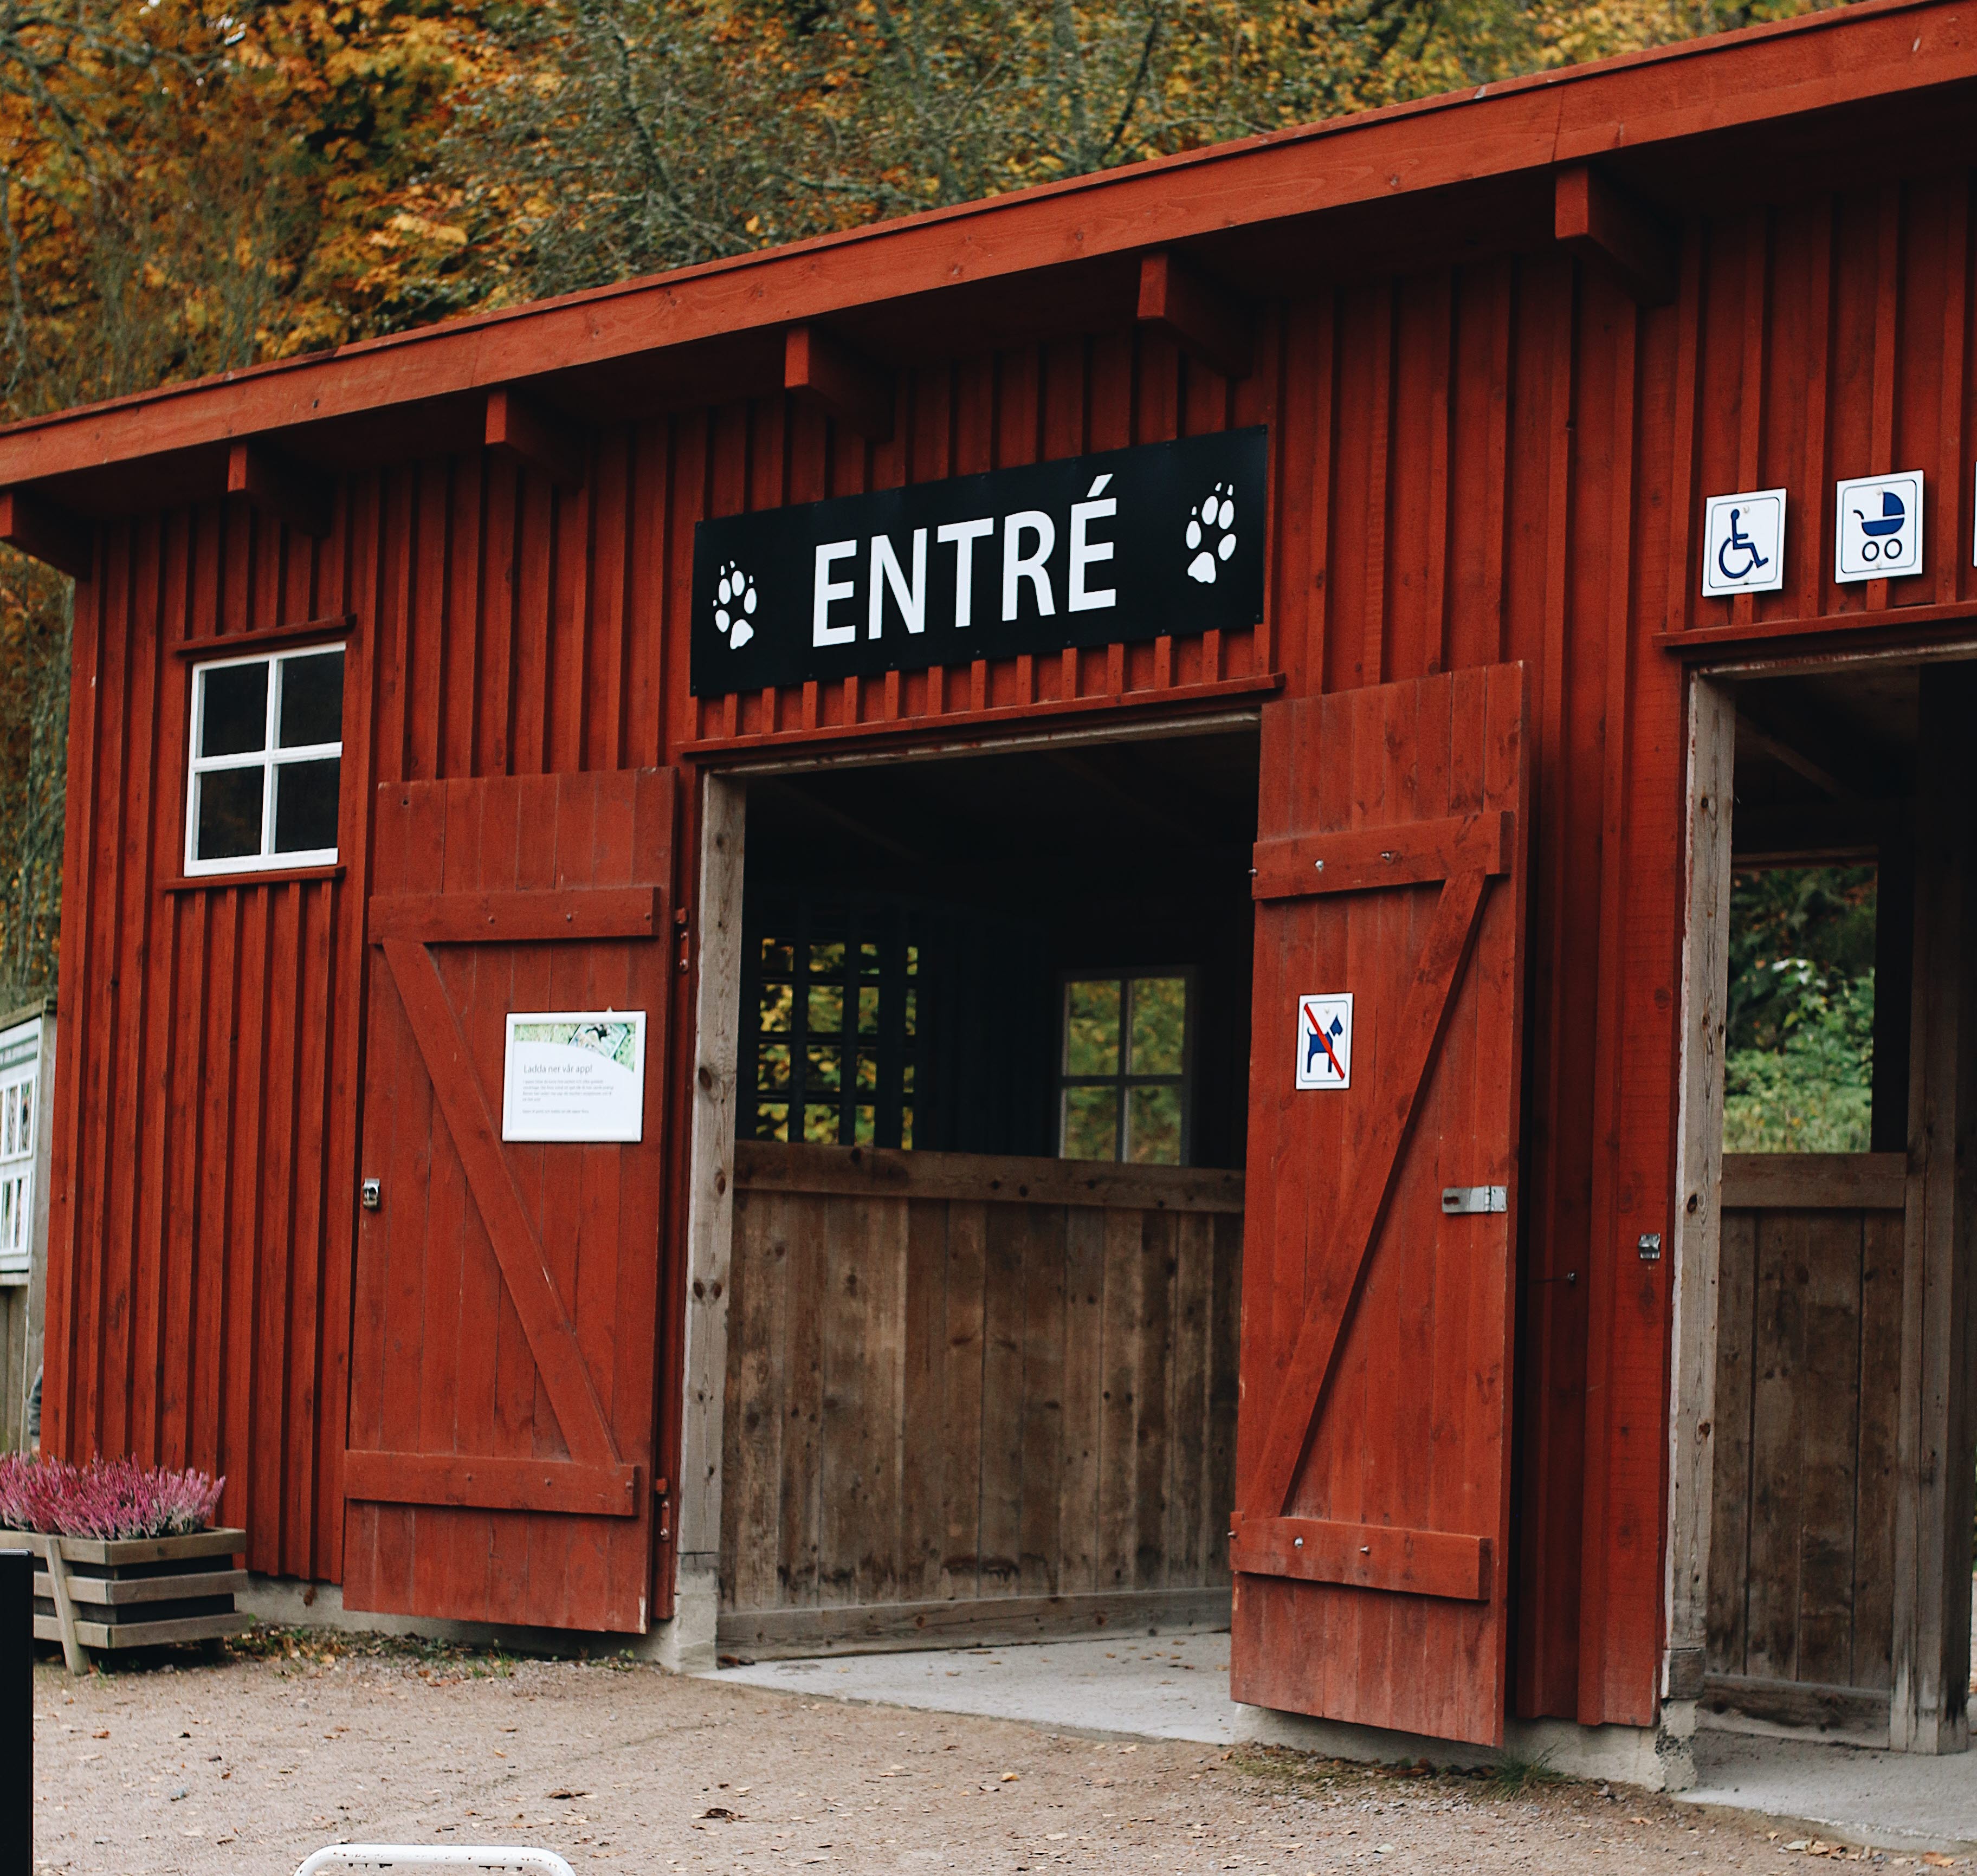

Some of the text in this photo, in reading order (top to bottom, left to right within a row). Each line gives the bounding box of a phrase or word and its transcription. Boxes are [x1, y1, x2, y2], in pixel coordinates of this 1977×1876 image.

[813, 474, 1116, 647] ENTRÉ
[524, 1064, 546, 1073] Ladda
[562, 1064, 574, 1073] vår
[576, 1065, 592, 1076] app!
